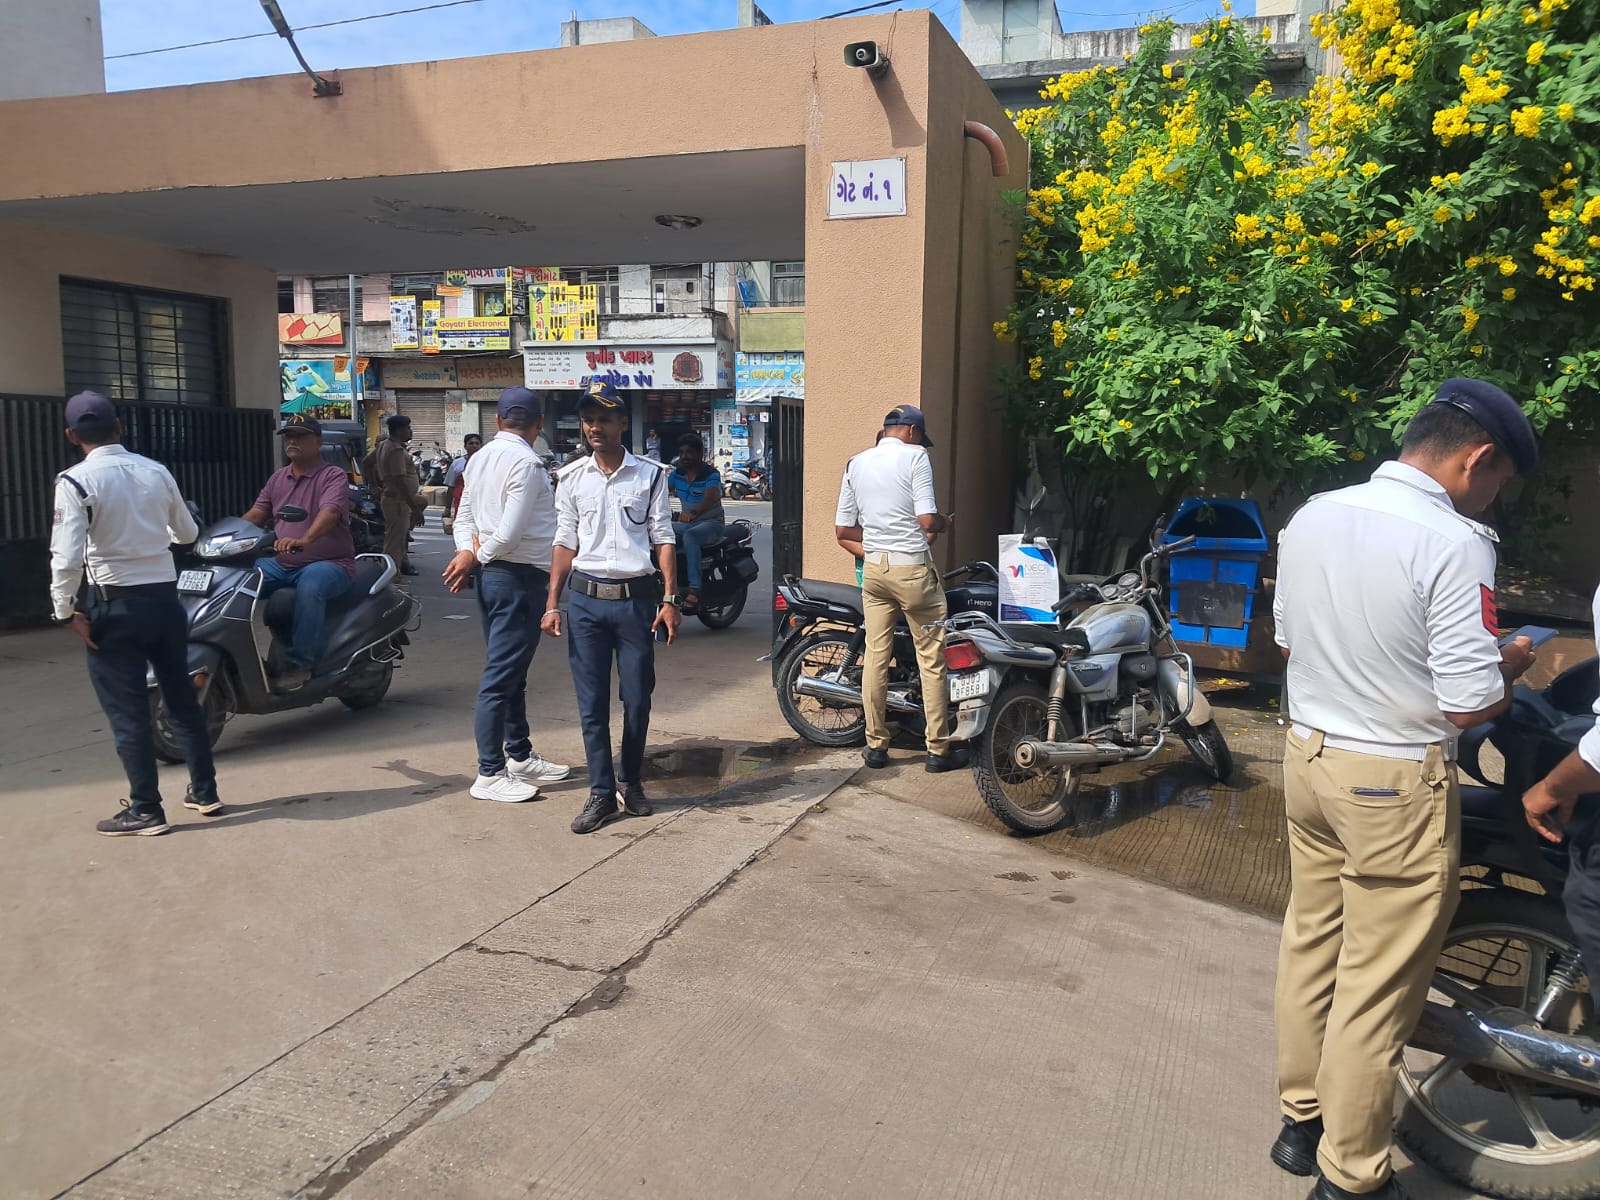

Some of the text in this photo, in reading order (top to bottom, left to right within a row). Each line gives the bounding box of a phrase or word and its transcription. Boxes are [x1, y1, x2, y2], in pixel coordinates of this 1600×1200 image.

[837, 173, 856, 202] ગેટ
[883, 179, 892, 200] ૧
[439, 319, 506, 329] Gayatri Electronics
[974, 599, 992, 607] Hero
